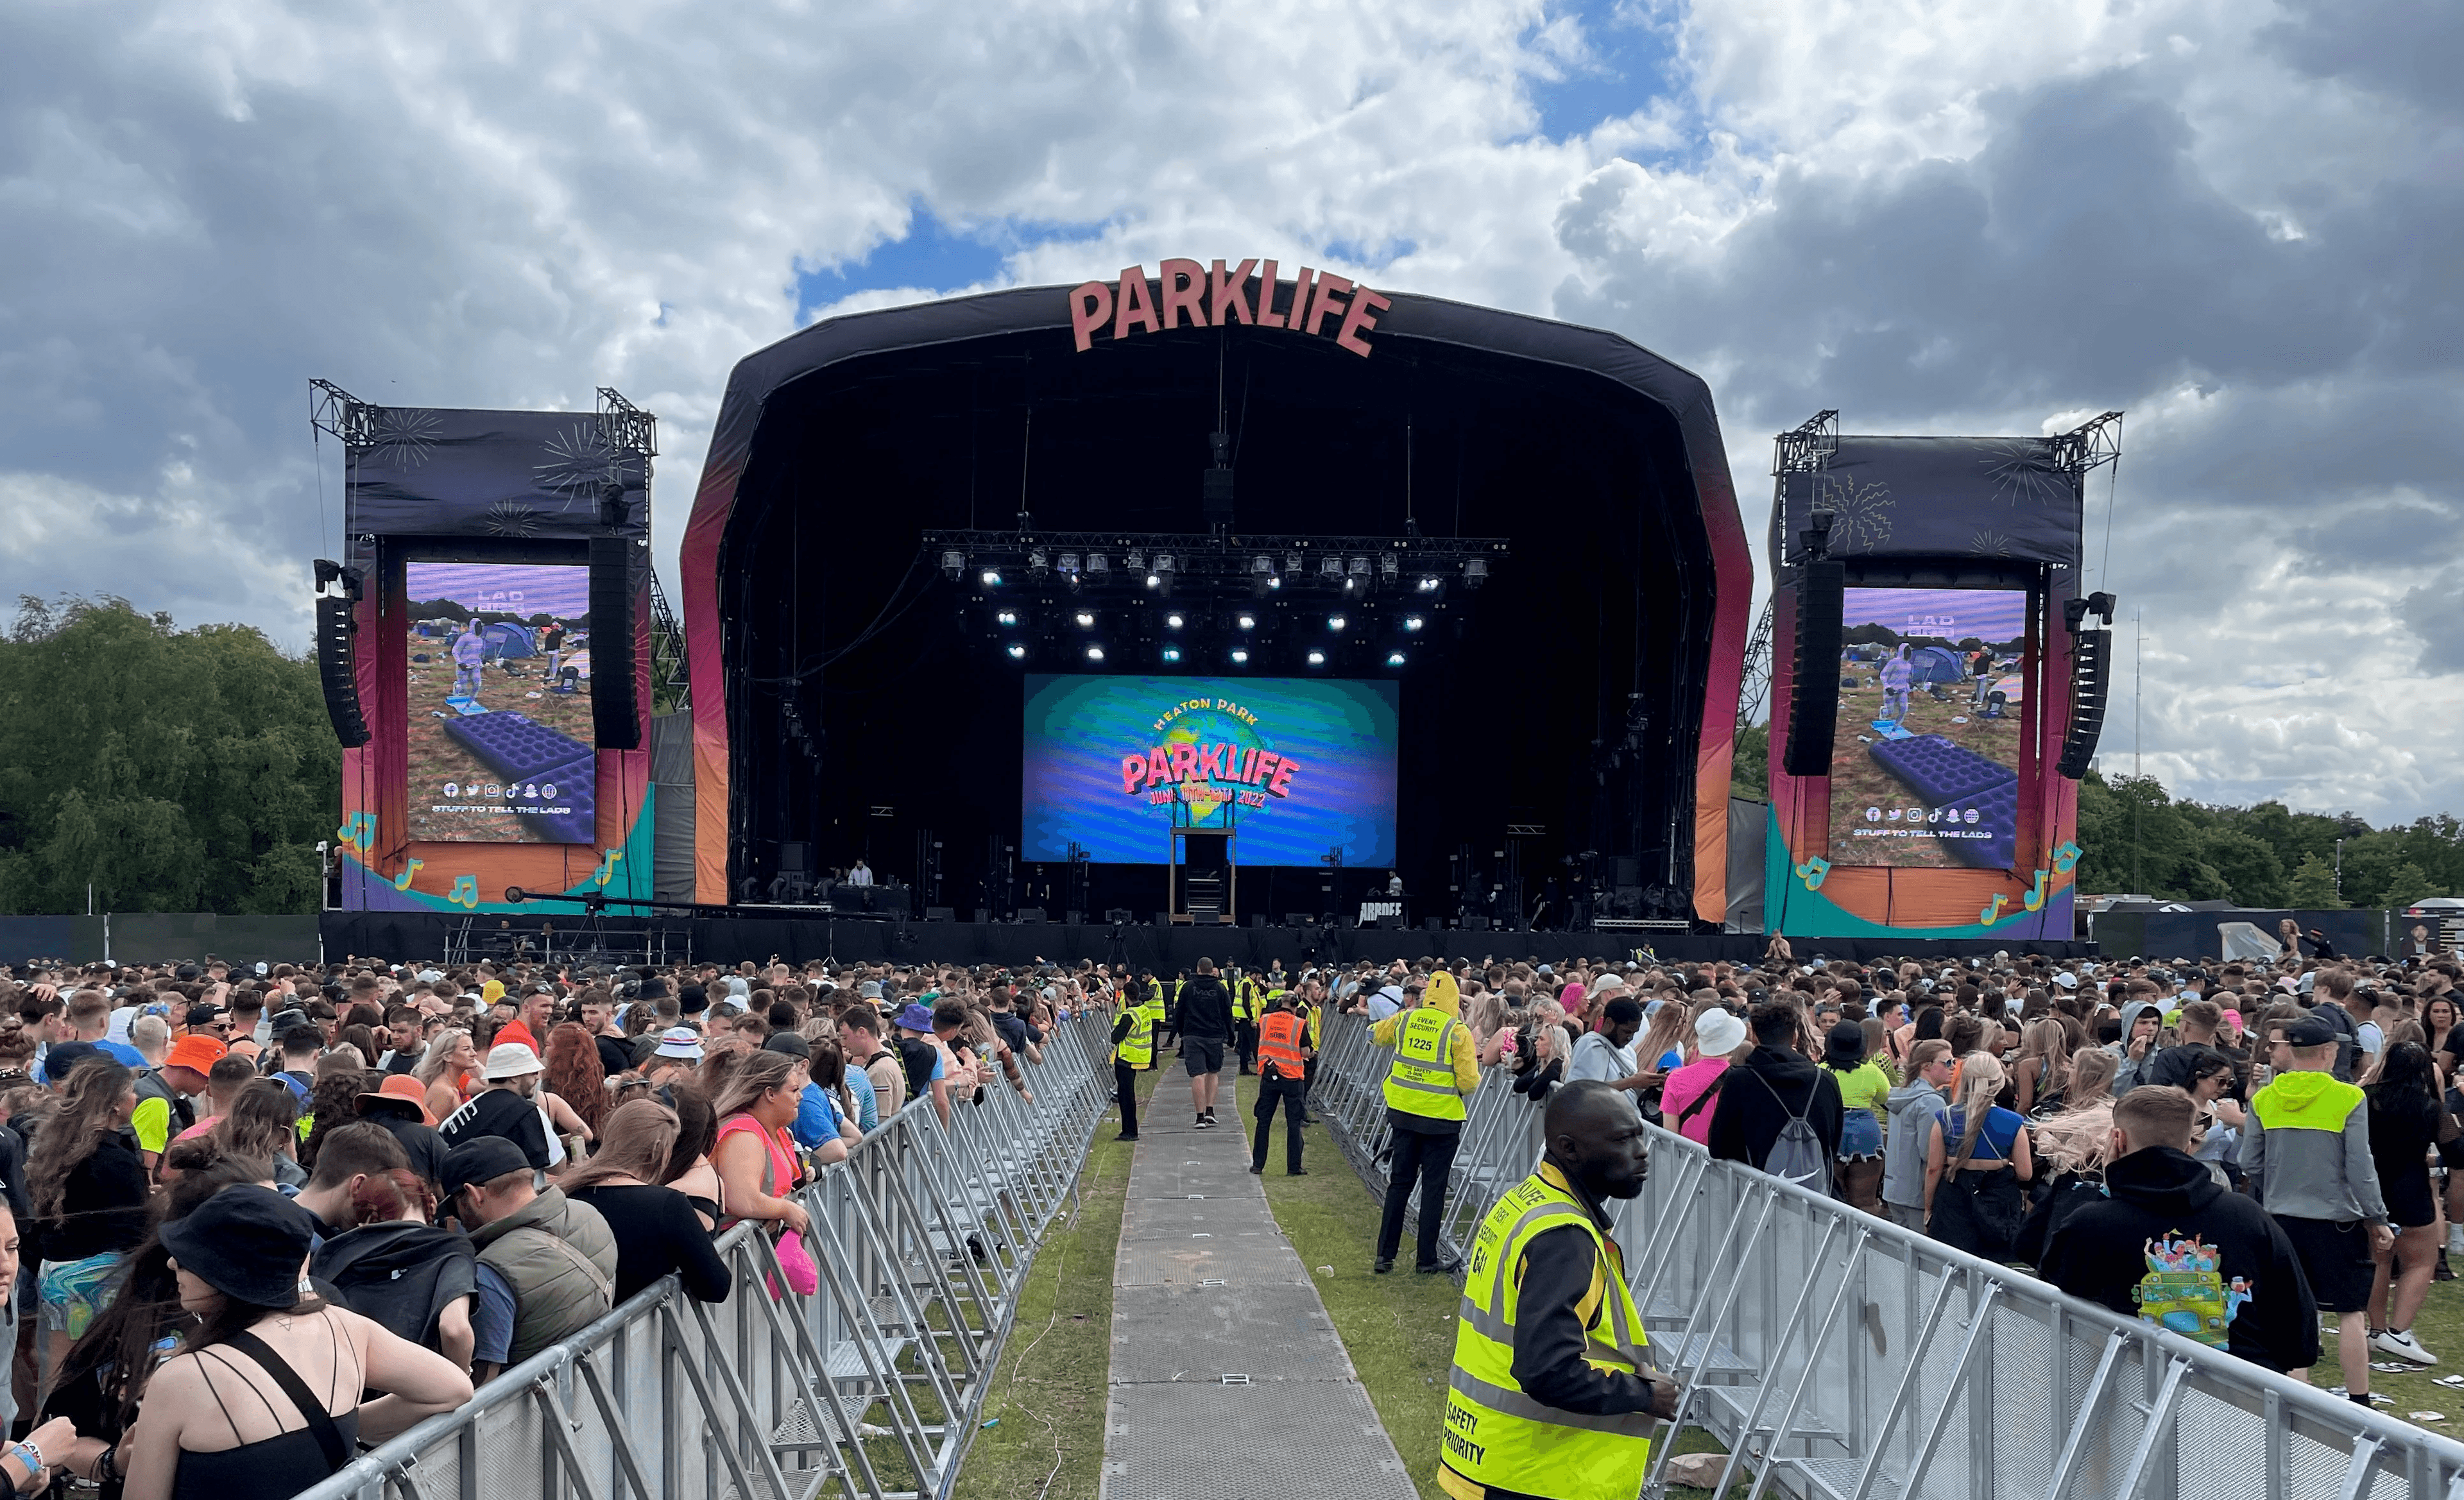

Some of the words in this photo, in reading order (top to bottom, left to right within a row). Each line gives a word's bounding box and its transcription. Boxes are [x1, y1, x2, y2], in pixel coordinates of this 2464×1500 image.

[1068, 258, 1392, 358] PARKLIFE
[478, 590, 524, 601] LAD
[1908, 615, 1955, 625] LAD
[1153, 698, 1211, 730] HEATON
[1217, 699, 1258, 726] PARK
[1123, 743, 1301, 797] PARKLIFE
[1853, 828, 1890, 837] STUFF
[1410, 1022, 1439, 1034] SECURITY
[1417, 1016, 1437, 1026] EVENT
[1409, 1037, 1432, 1051] 1225
[1446, 1401, 1478, 1435] SAFETY
[1442, 1426, 1486, 1465] PRIORITY
